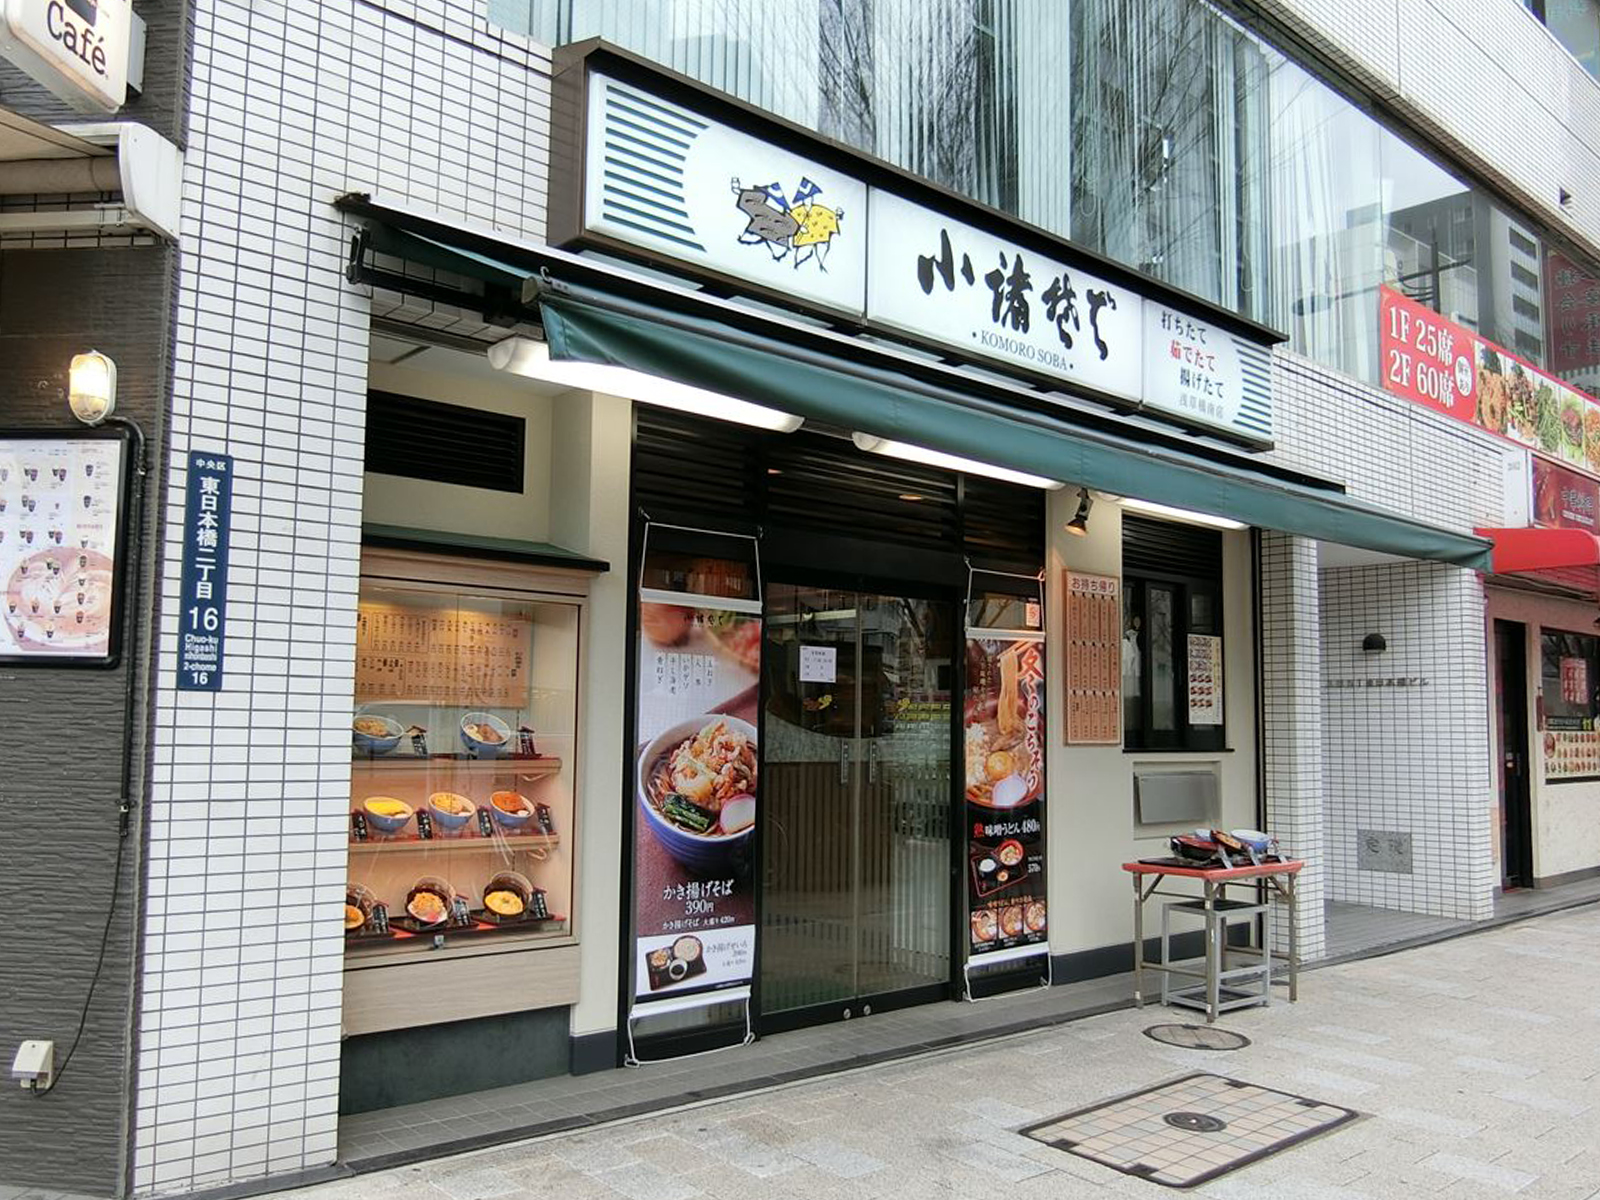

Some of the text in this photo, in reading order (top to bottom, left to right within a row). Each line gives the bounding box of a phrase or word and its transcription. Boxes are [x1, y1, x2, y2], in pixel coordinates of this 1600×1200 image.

[48, 0, 107, 75] Café
[1161, 310, 1208, 345] 打ちたて
[1388, 306, 1454, 367] 1F 25席
[981, 329, 1068, 373] KOMORO SOBA
[1389, 349, 1412, 388] 2F
[1416, 362, 1454, 409] 60席
[196, 458, 226, 471] 中央区
[195, 476, 220, 600] 東日本橋二丁目
[1071, 577, 1116, 594] お持ち帰り
[188, 606, 219, 631] 16
[185, 633, 219, 644] Chuo-ku
[183, 661, 218, 671] 2-chome
[191, 672, 209, 685] 16
[663, 879, 735, 901] かき揚げそば
[685, 900, 715, 915] 390円
